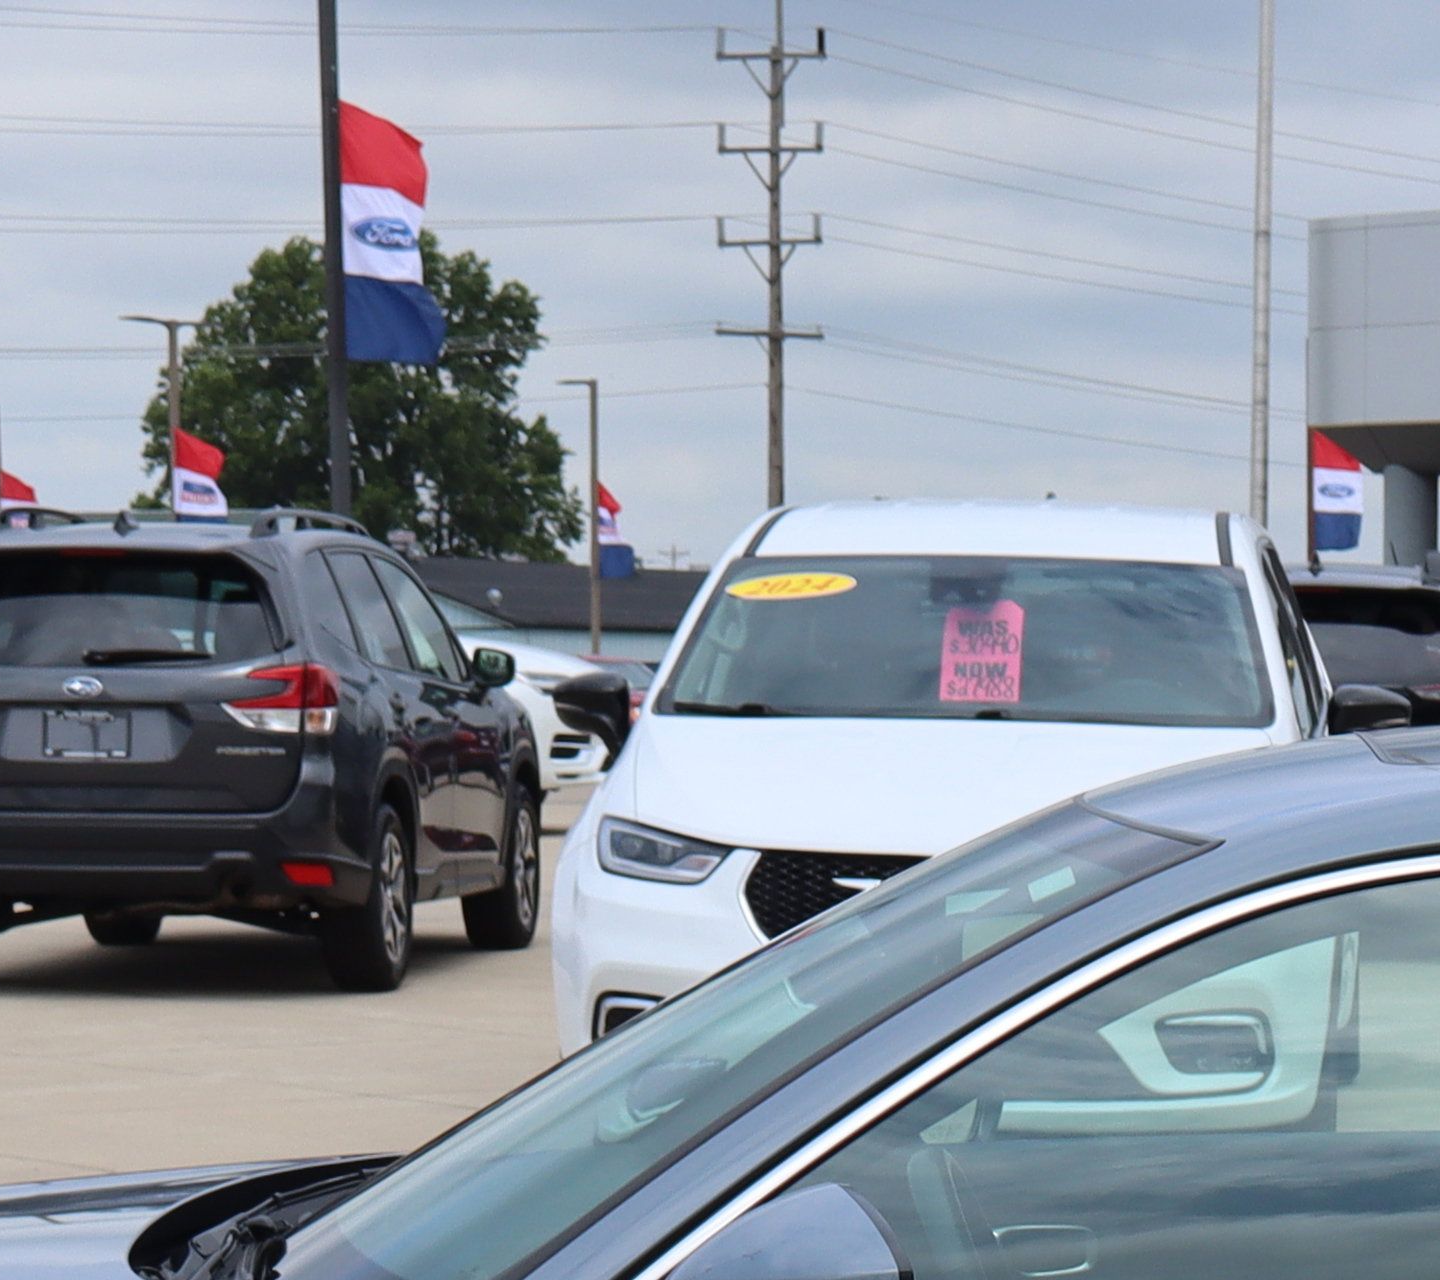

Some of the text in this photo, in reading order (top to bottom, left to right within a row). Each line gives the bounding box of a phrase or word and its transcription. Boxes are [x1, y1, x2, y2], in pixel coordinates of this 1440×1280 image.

[742, 575, 839, 595] 2024
[958, 620, 1009, 637] WAS
[953, 661, 1008, 678] NOW
